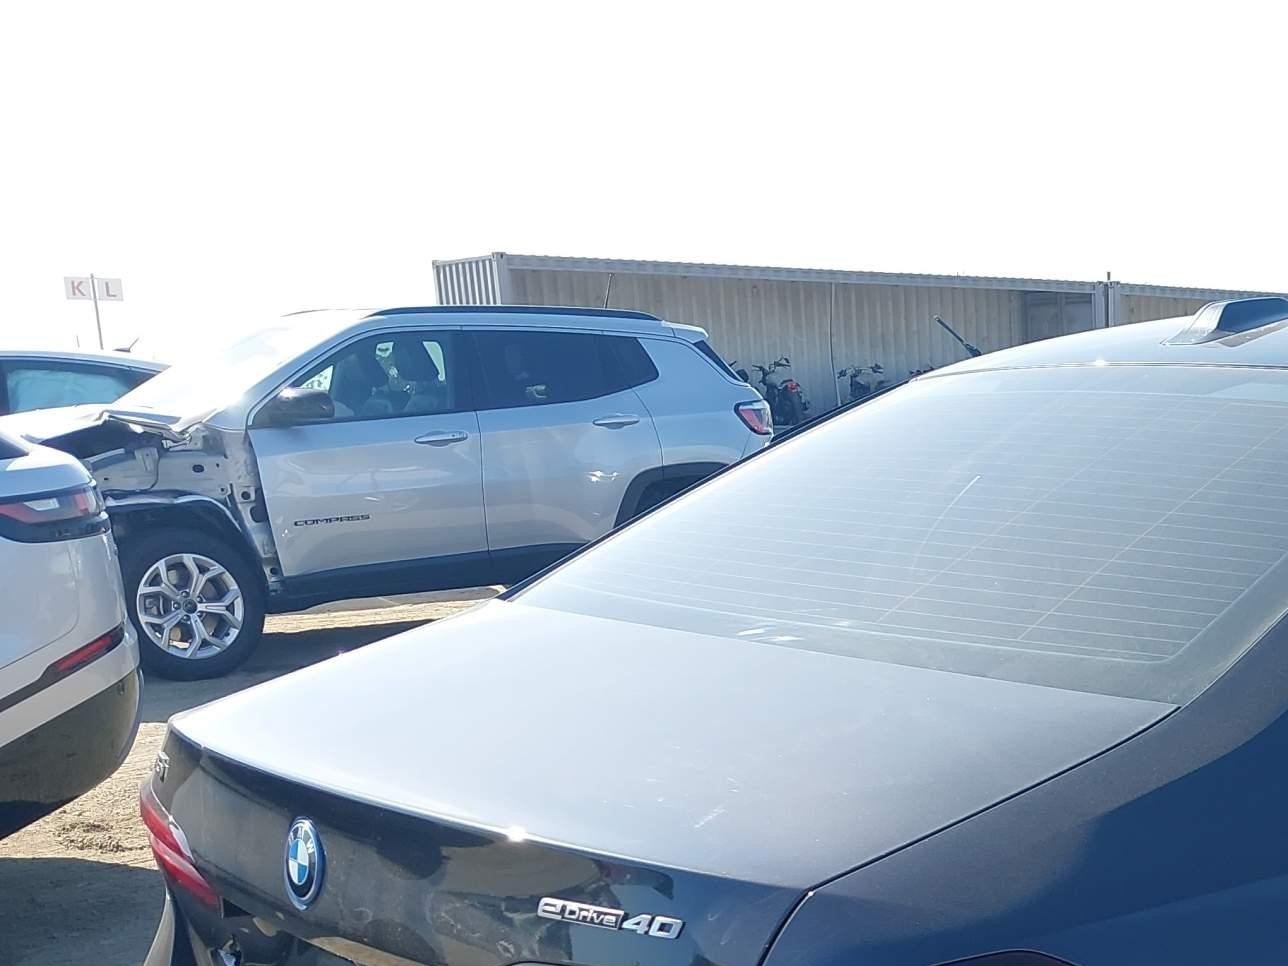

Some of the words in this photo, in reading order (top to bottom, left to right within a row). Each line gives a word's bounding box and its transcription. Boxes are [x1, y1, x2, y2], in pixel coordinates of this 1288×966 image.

[71, 280, 86, 297] K
[105, 281, 117, 298] L
[294, 514, 370, 527] COMPASS
